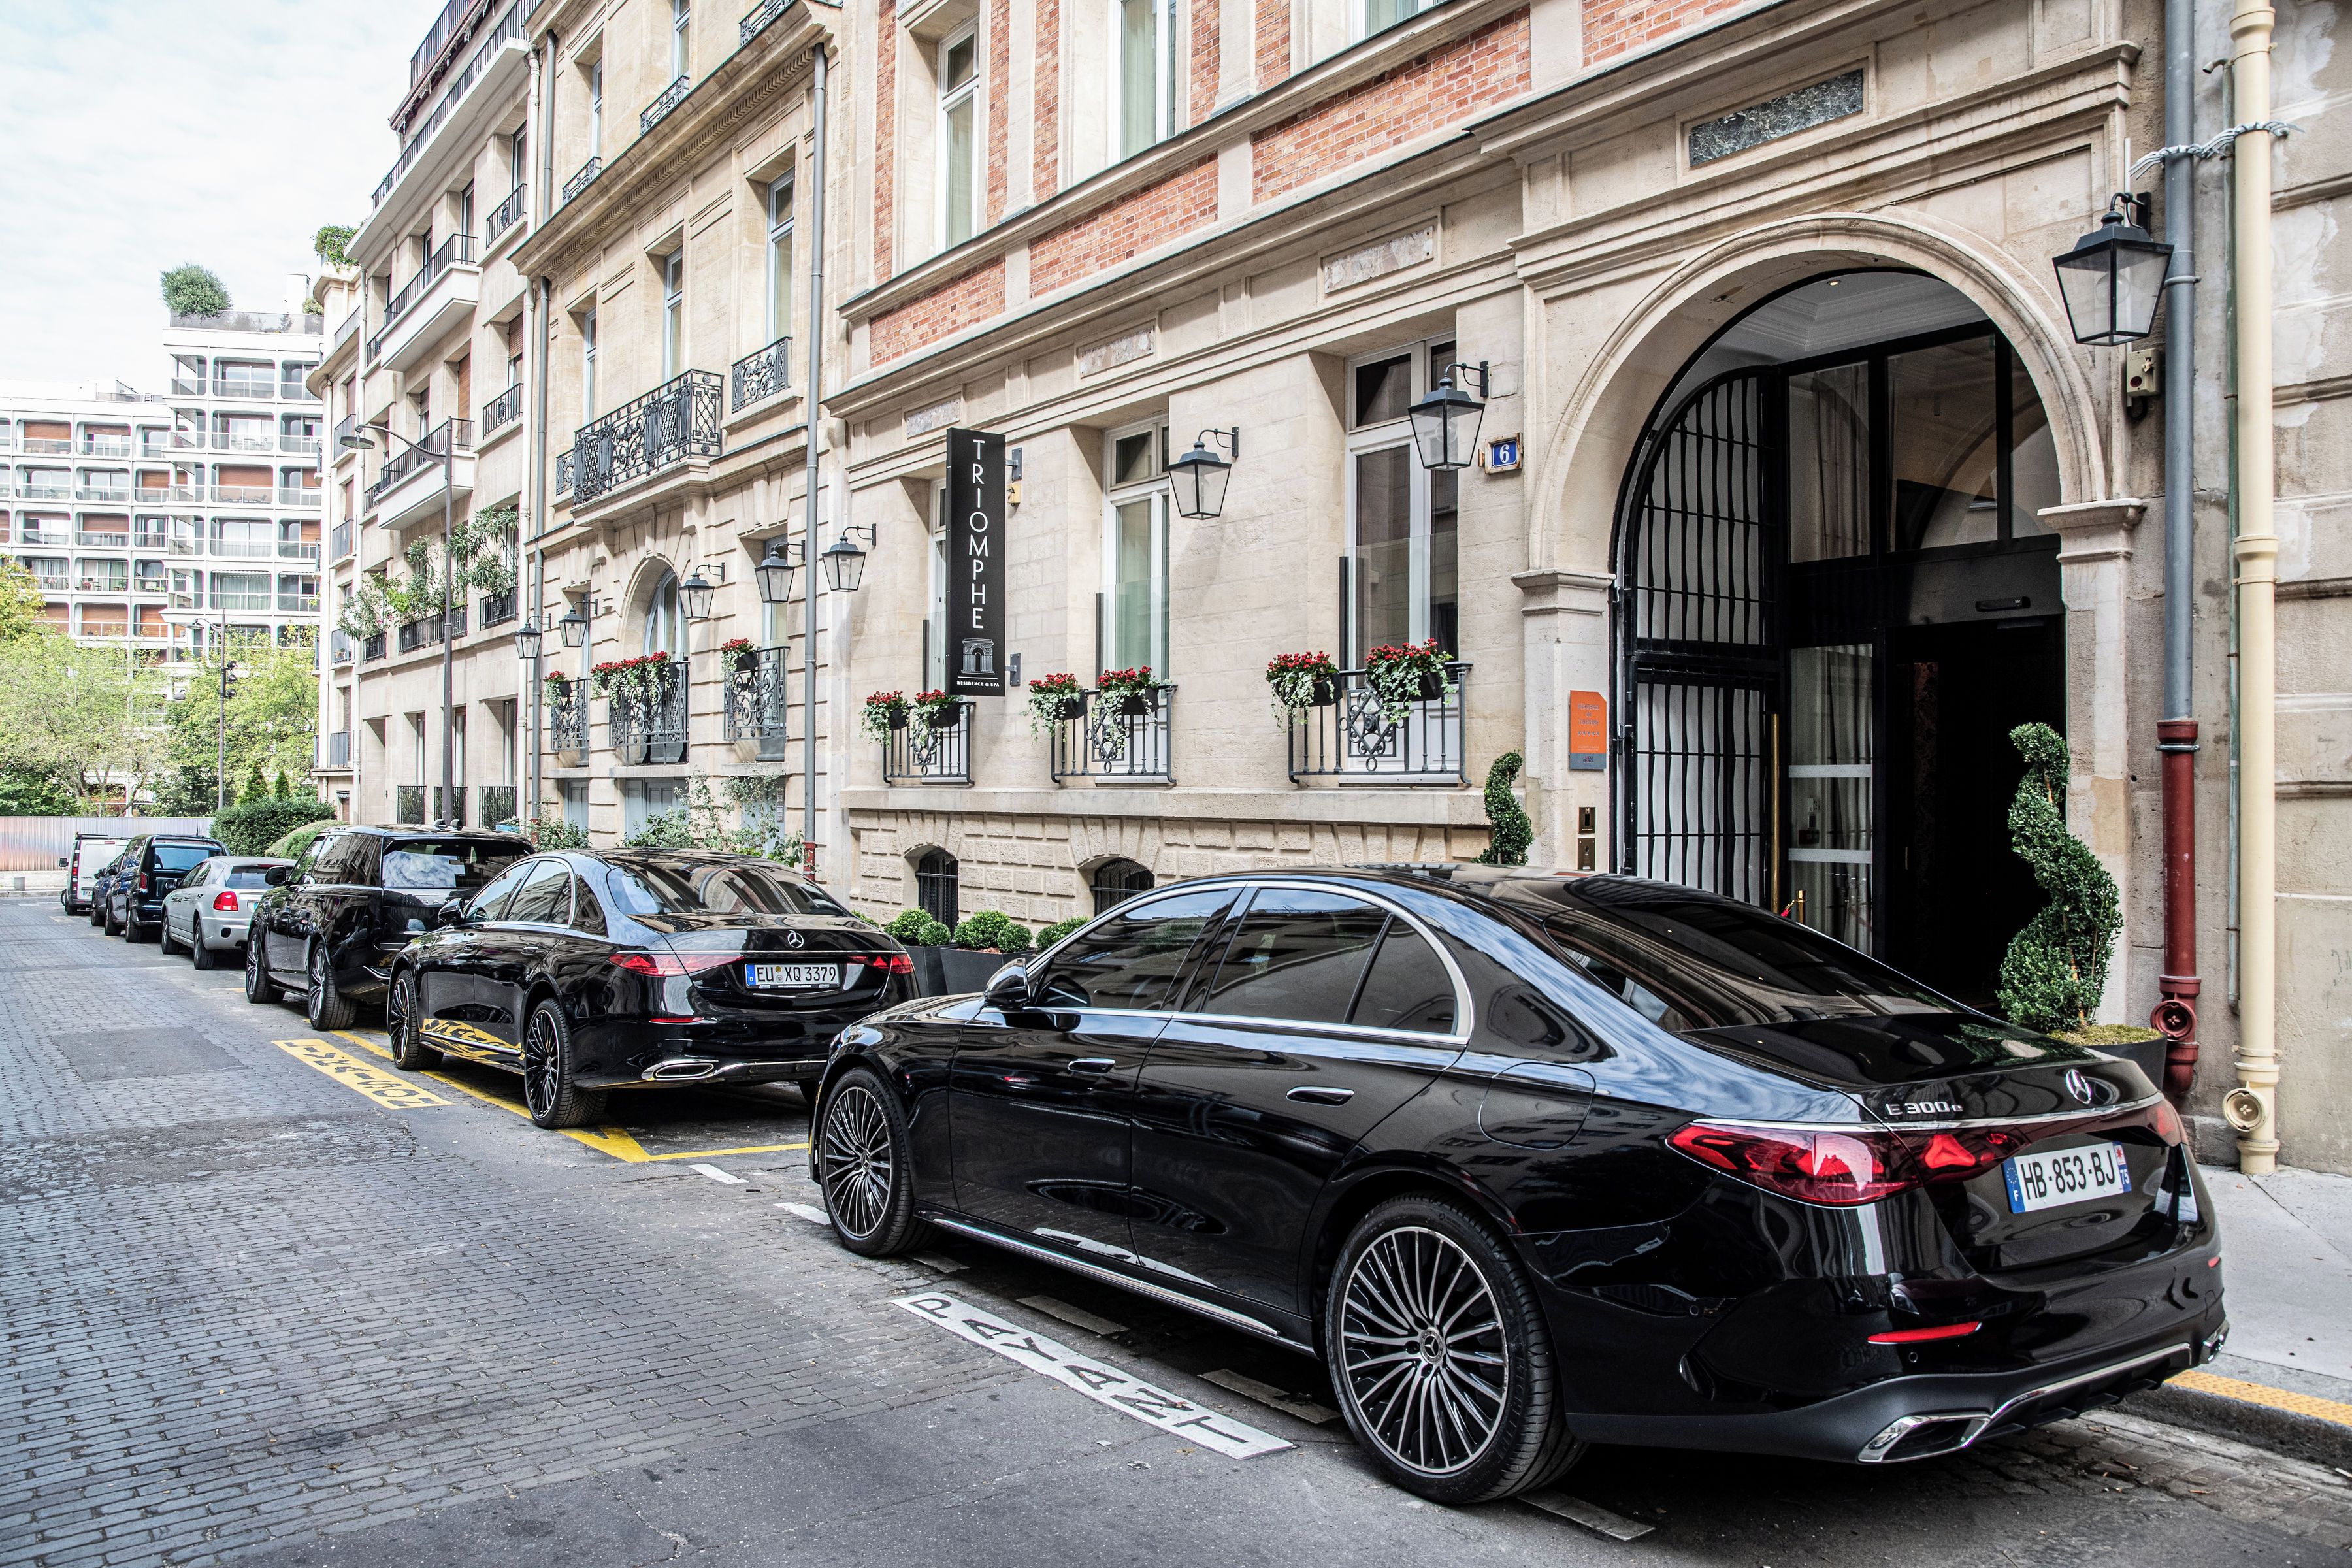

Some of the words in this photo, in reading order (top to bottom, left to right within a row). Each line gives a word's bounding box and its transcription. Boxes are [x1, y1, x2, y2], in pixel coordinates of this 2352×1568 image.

[1499, 444, 1510, 463] 6
[968, 438, 988, 629] TRIOMPHE
[757, 966, 774, 982] EU
[784, 966, 801, 982] XQ
[804, 966, 836, 982] 3379
[2020, 1150, 2116, 1200] HB-853-BJ
[2119, 1168, 2130, 1185] 75
[2013, 1190, 2019, 1202] F
[909, 1297, 1248, 1445] PAYANT
